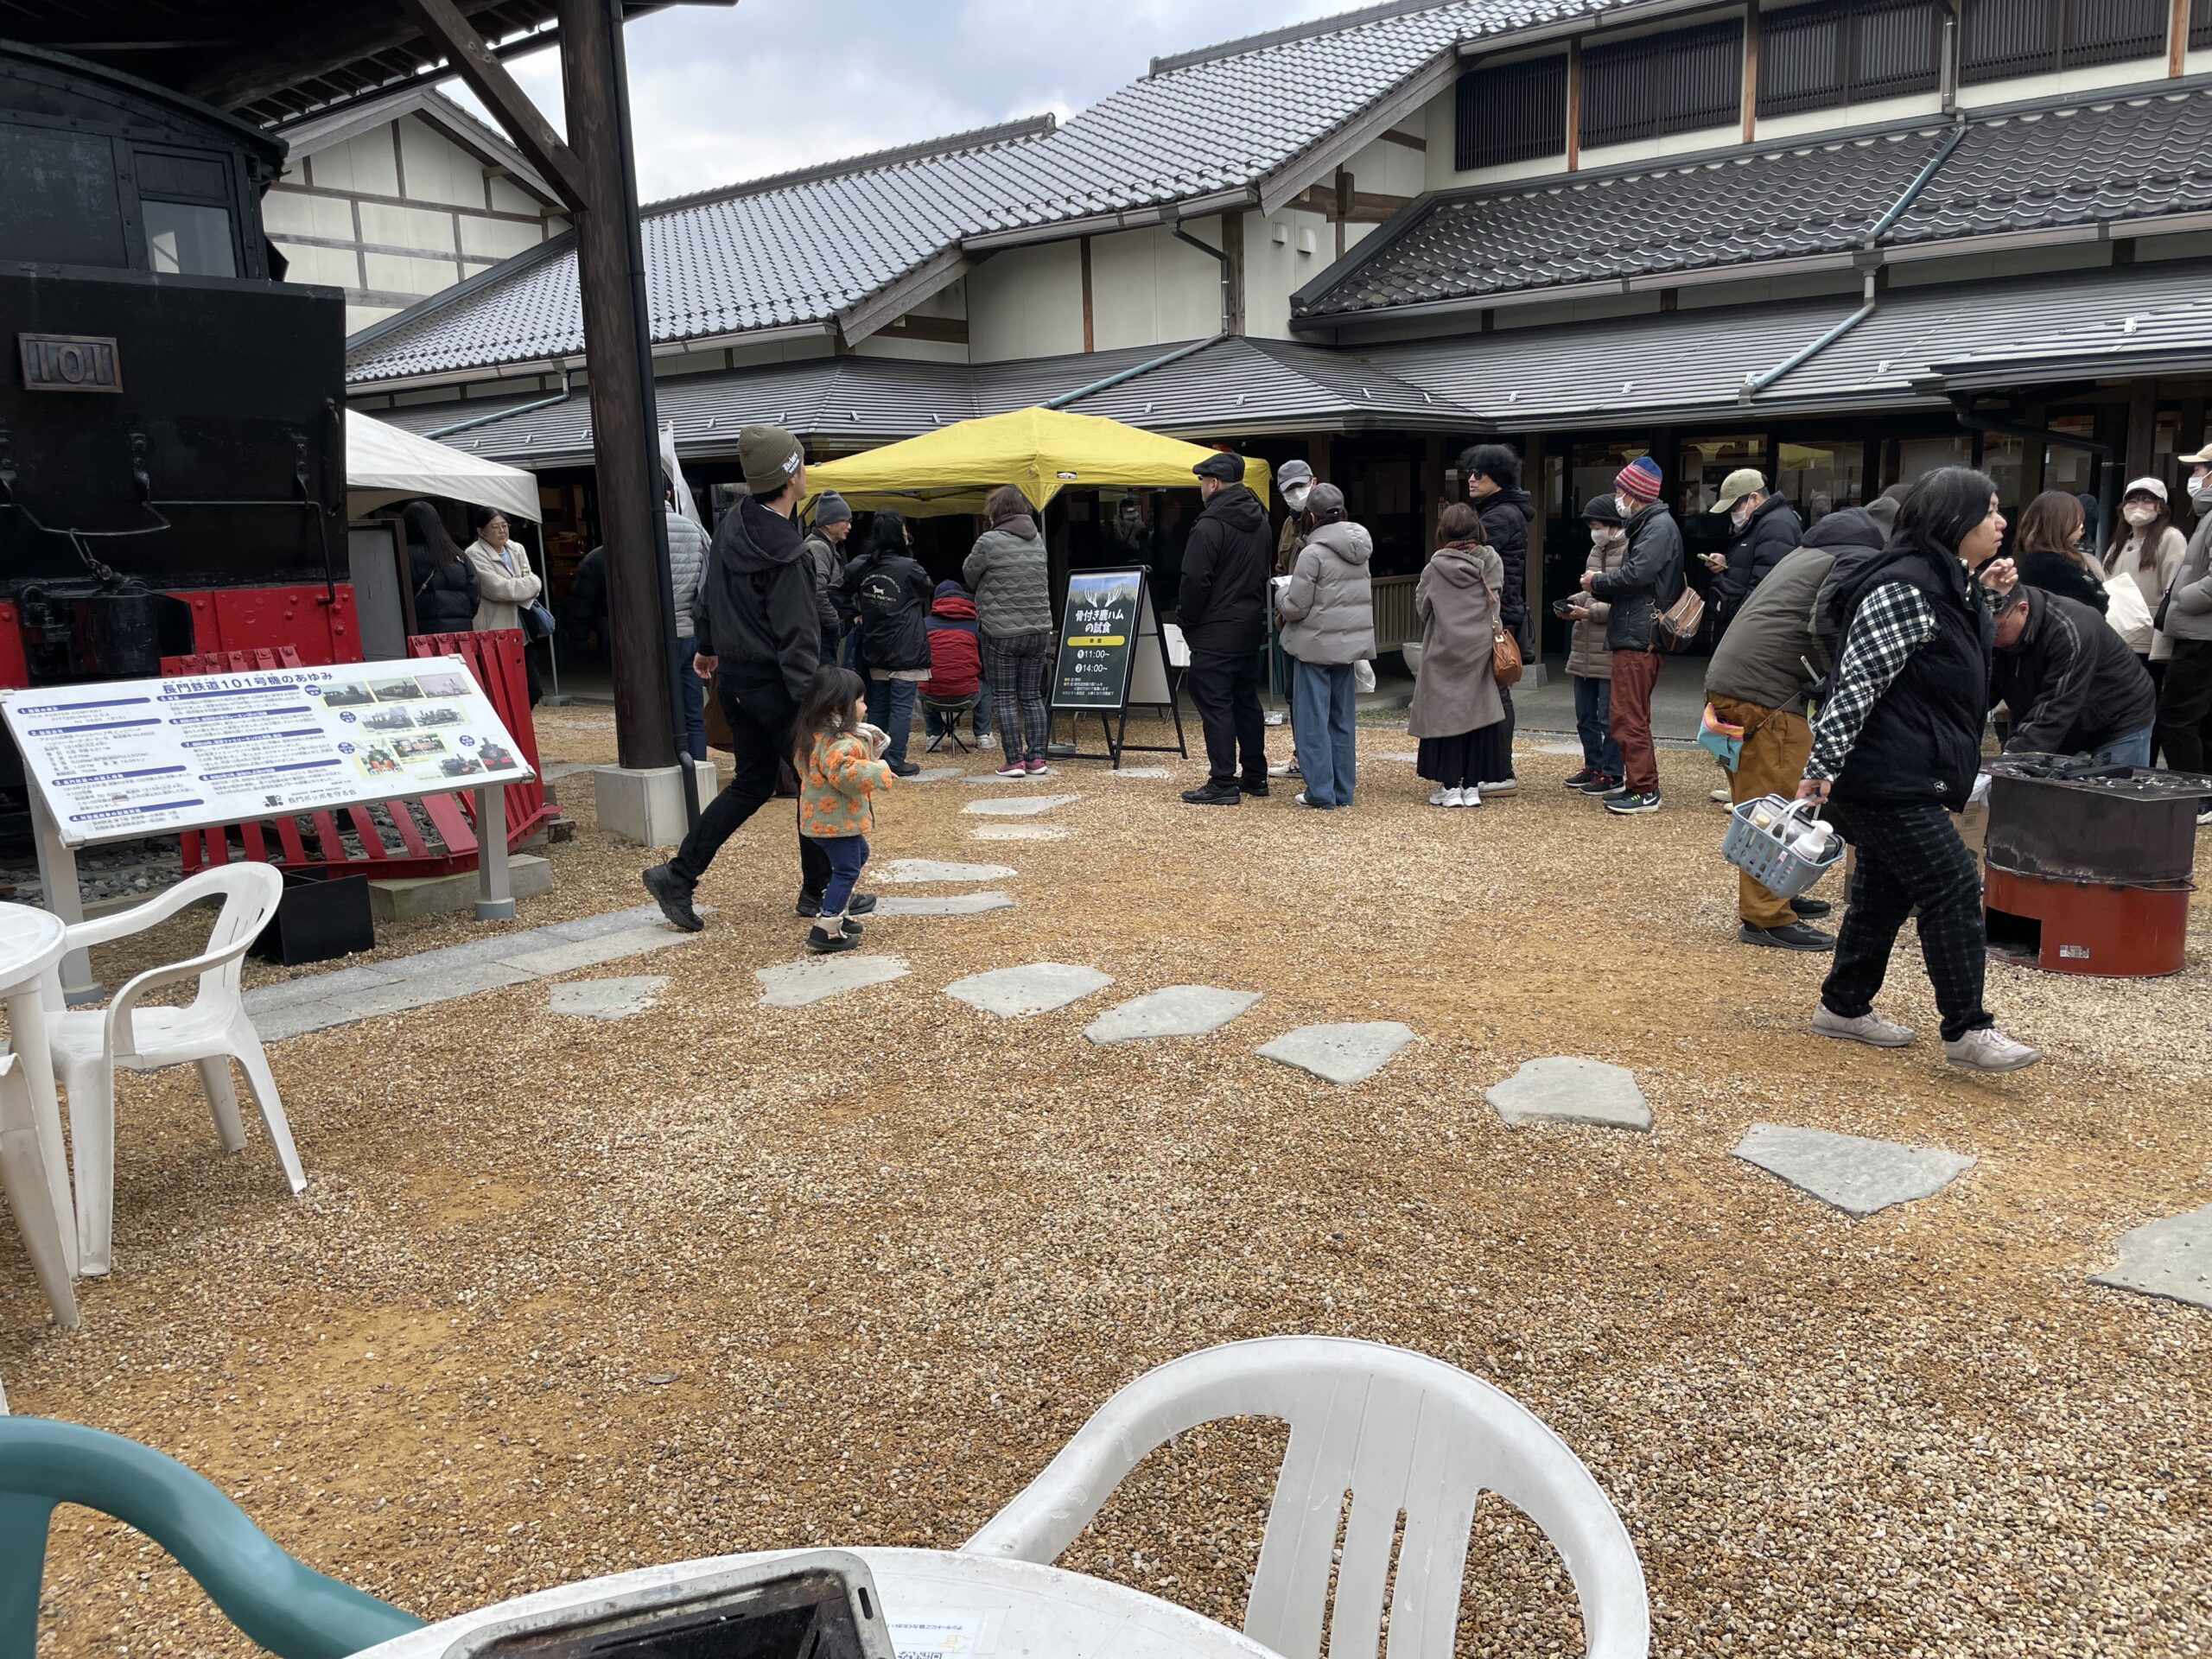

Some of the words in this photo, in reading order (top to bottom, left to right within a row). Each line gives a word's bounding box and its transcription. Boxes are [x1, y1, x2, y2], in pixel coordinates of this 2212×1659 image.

[35, 342, 109, 385] 101
[1075, 608, 1124, 622] 骨付き鹿ハム
[1084, 621, 1111, 633] の試食
[162, 671, 333, 695] 長門鉄道101号機のあゆみ
